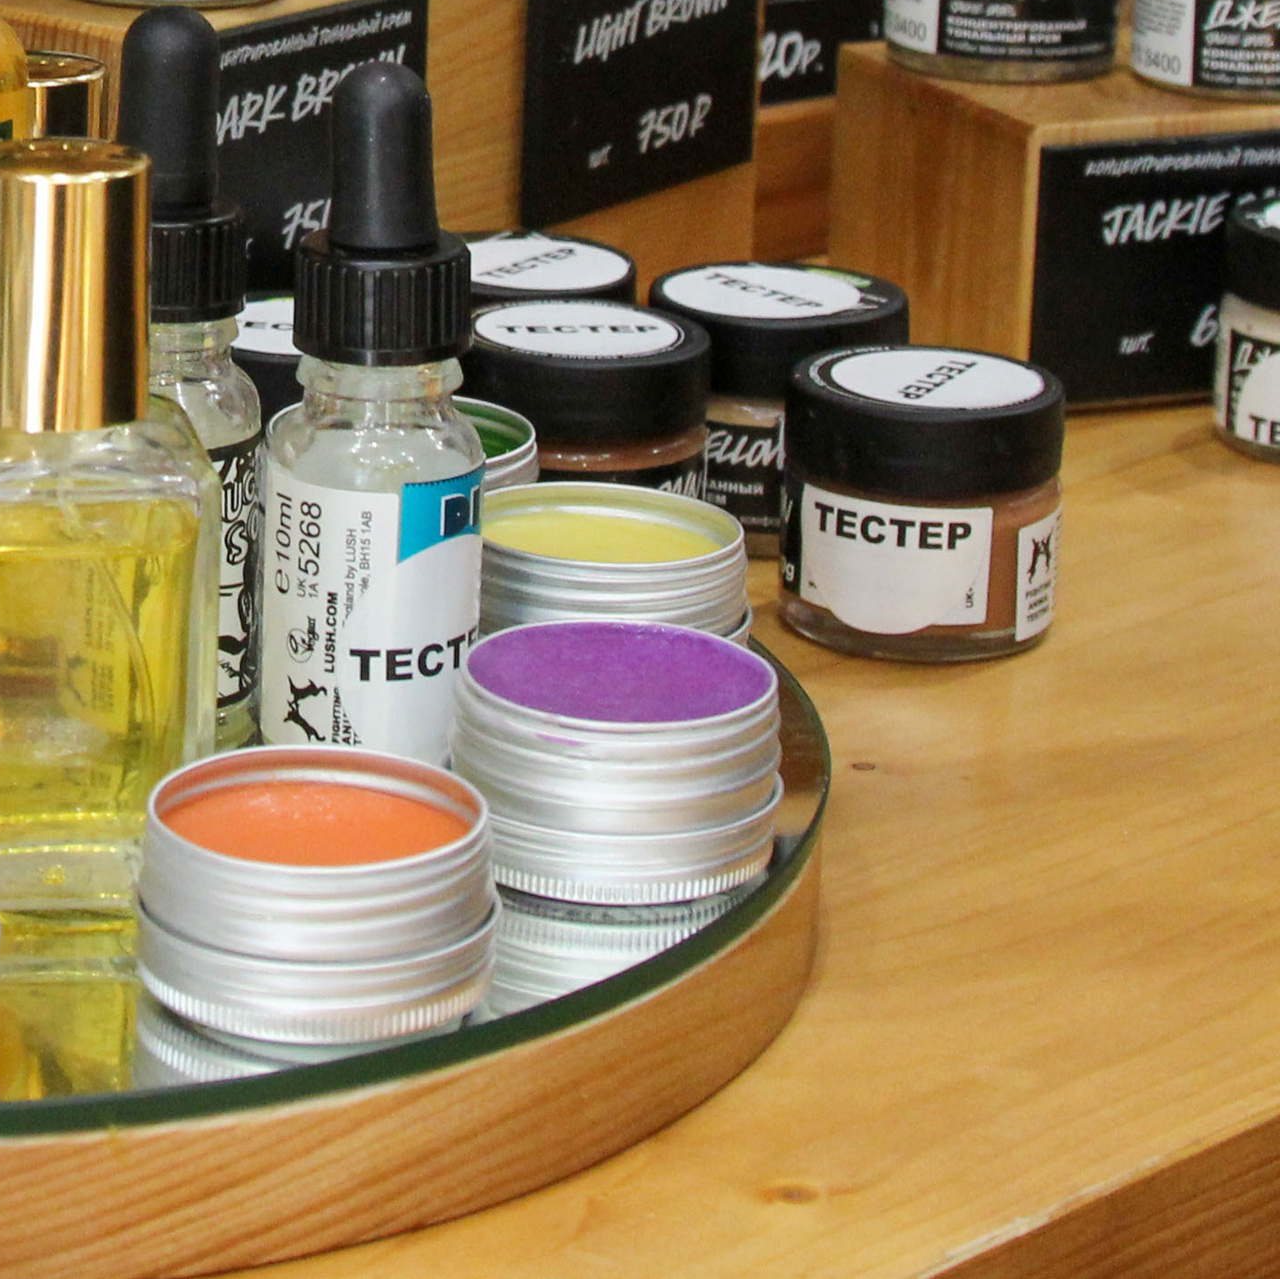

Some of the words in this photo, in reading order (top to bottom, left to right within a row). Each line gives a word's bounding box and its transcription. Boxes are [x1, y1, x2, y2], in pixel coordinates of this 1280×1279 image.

[216, 84, 288, 147] ARK
[1102, 192, 1231, 245] JACKIE
[477, 246, 577, 280] ТЕСТЕР
[705, 272, 824, 309] ТЕСТЕР
[243, 320, 295, 332] ЕС
[496, 323, 660, 337] ТЕСТЕР
[897, 360, 977, 401] ТЕСТЕР
[1249, 413, 1280, 447] ТЕ
[707, 480, 765, 495] АННЫЙ
[275, 492, 293, 563] 10ml
[360, 510, 372, 533] 1AB
[814, 501, 973, 550] ТЕСТЕР
[297, 501, 322, 577] 5268
[345, 528, 357, 564] LUSH
[360, 537, 371, 570] BH15
[297, 578, 307, 598] UK
[344, 564, 356, 580] by
[308, 582, 319, 598] 1A
[324, 591, 338, 674] LUSH.COM
